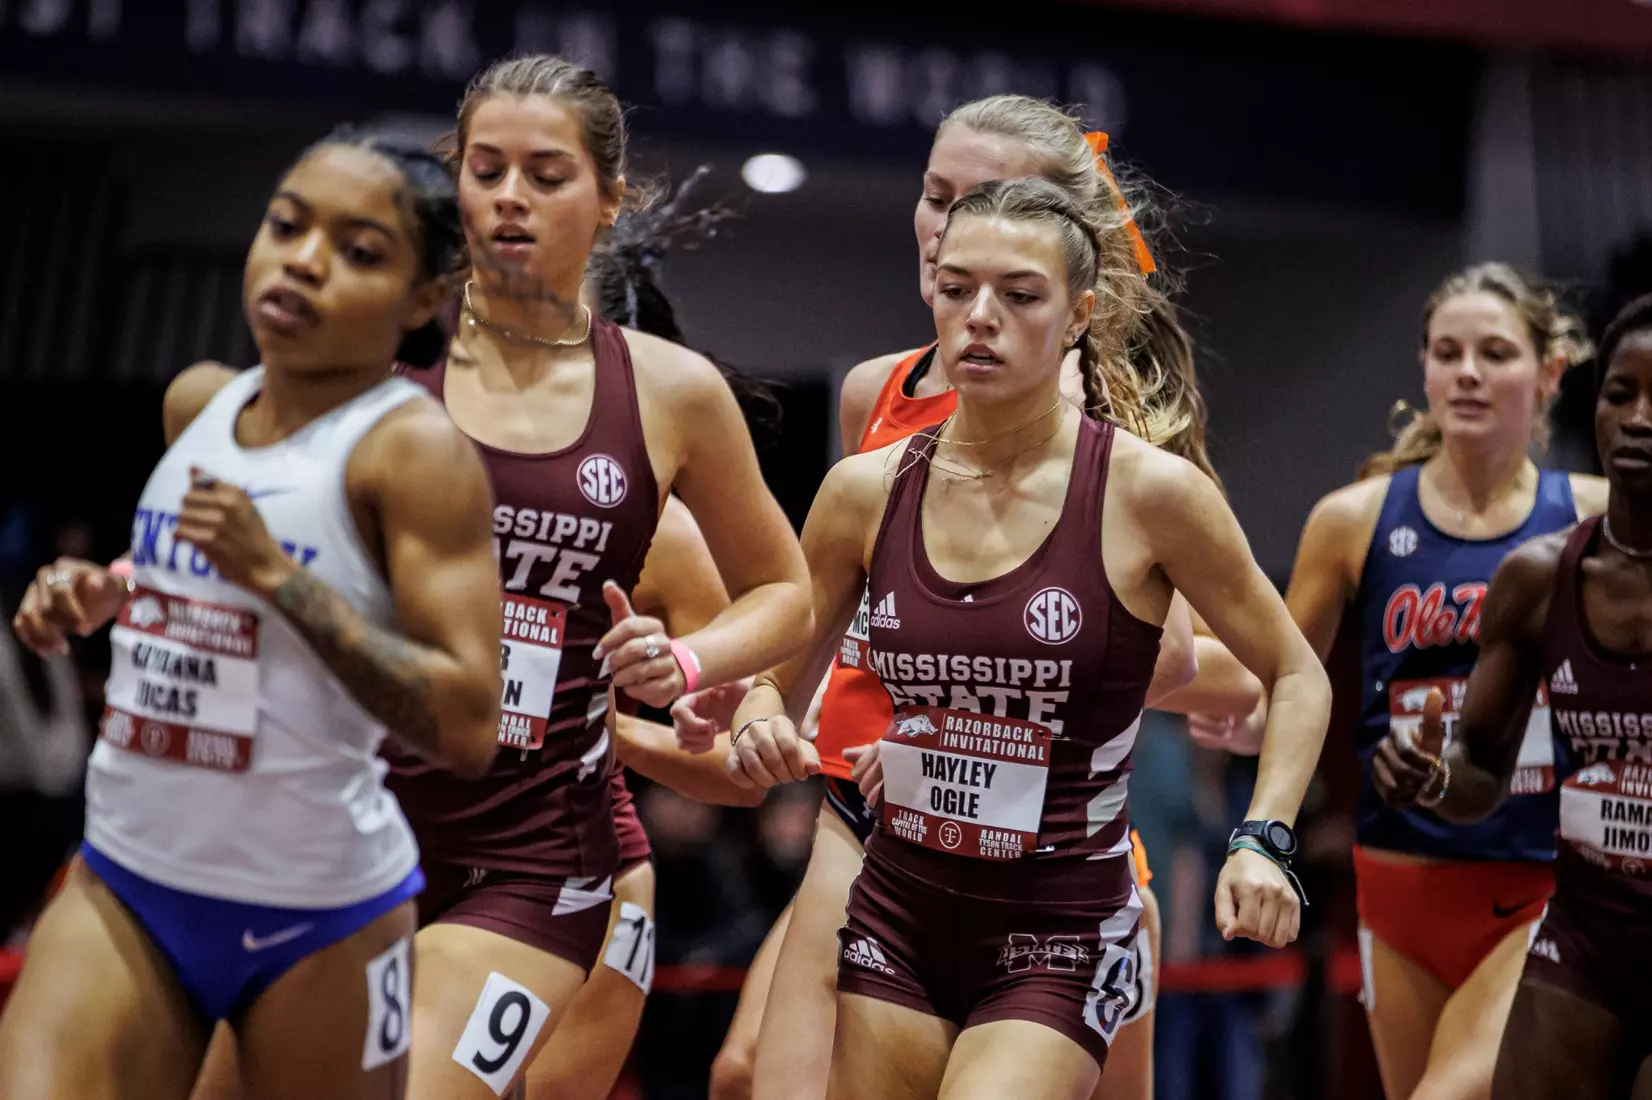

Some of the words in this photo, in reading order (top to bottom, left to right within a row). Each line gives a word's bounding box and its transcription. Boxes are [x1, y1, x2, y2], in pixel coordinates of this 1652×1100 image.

[580, 457, 624, 505] SEC
[492, 538, 600, 604] TE
[504, 600, 548, 625] BACK
[870, 614, 901, 630] adidas
[1028, 590, 1079, 641] SEC
[503, 619, 559, 645] TIONAL
[872, 650, 1073, 688] MISSISSIPPI
[946, 716, 1034, 743] RAZORBACK
[943, 732, 1045, 761] INVITATIONAL
[921, 752, 998, 789] HAYLEY
[898, 809, 925, 826] TRACK
[930, 786, 980, 819] OGLE
[980, 829, 1022, 844] RANDAL
[379, 956, 402, 1053] 8
[472, 991, 531, 1074] 9
